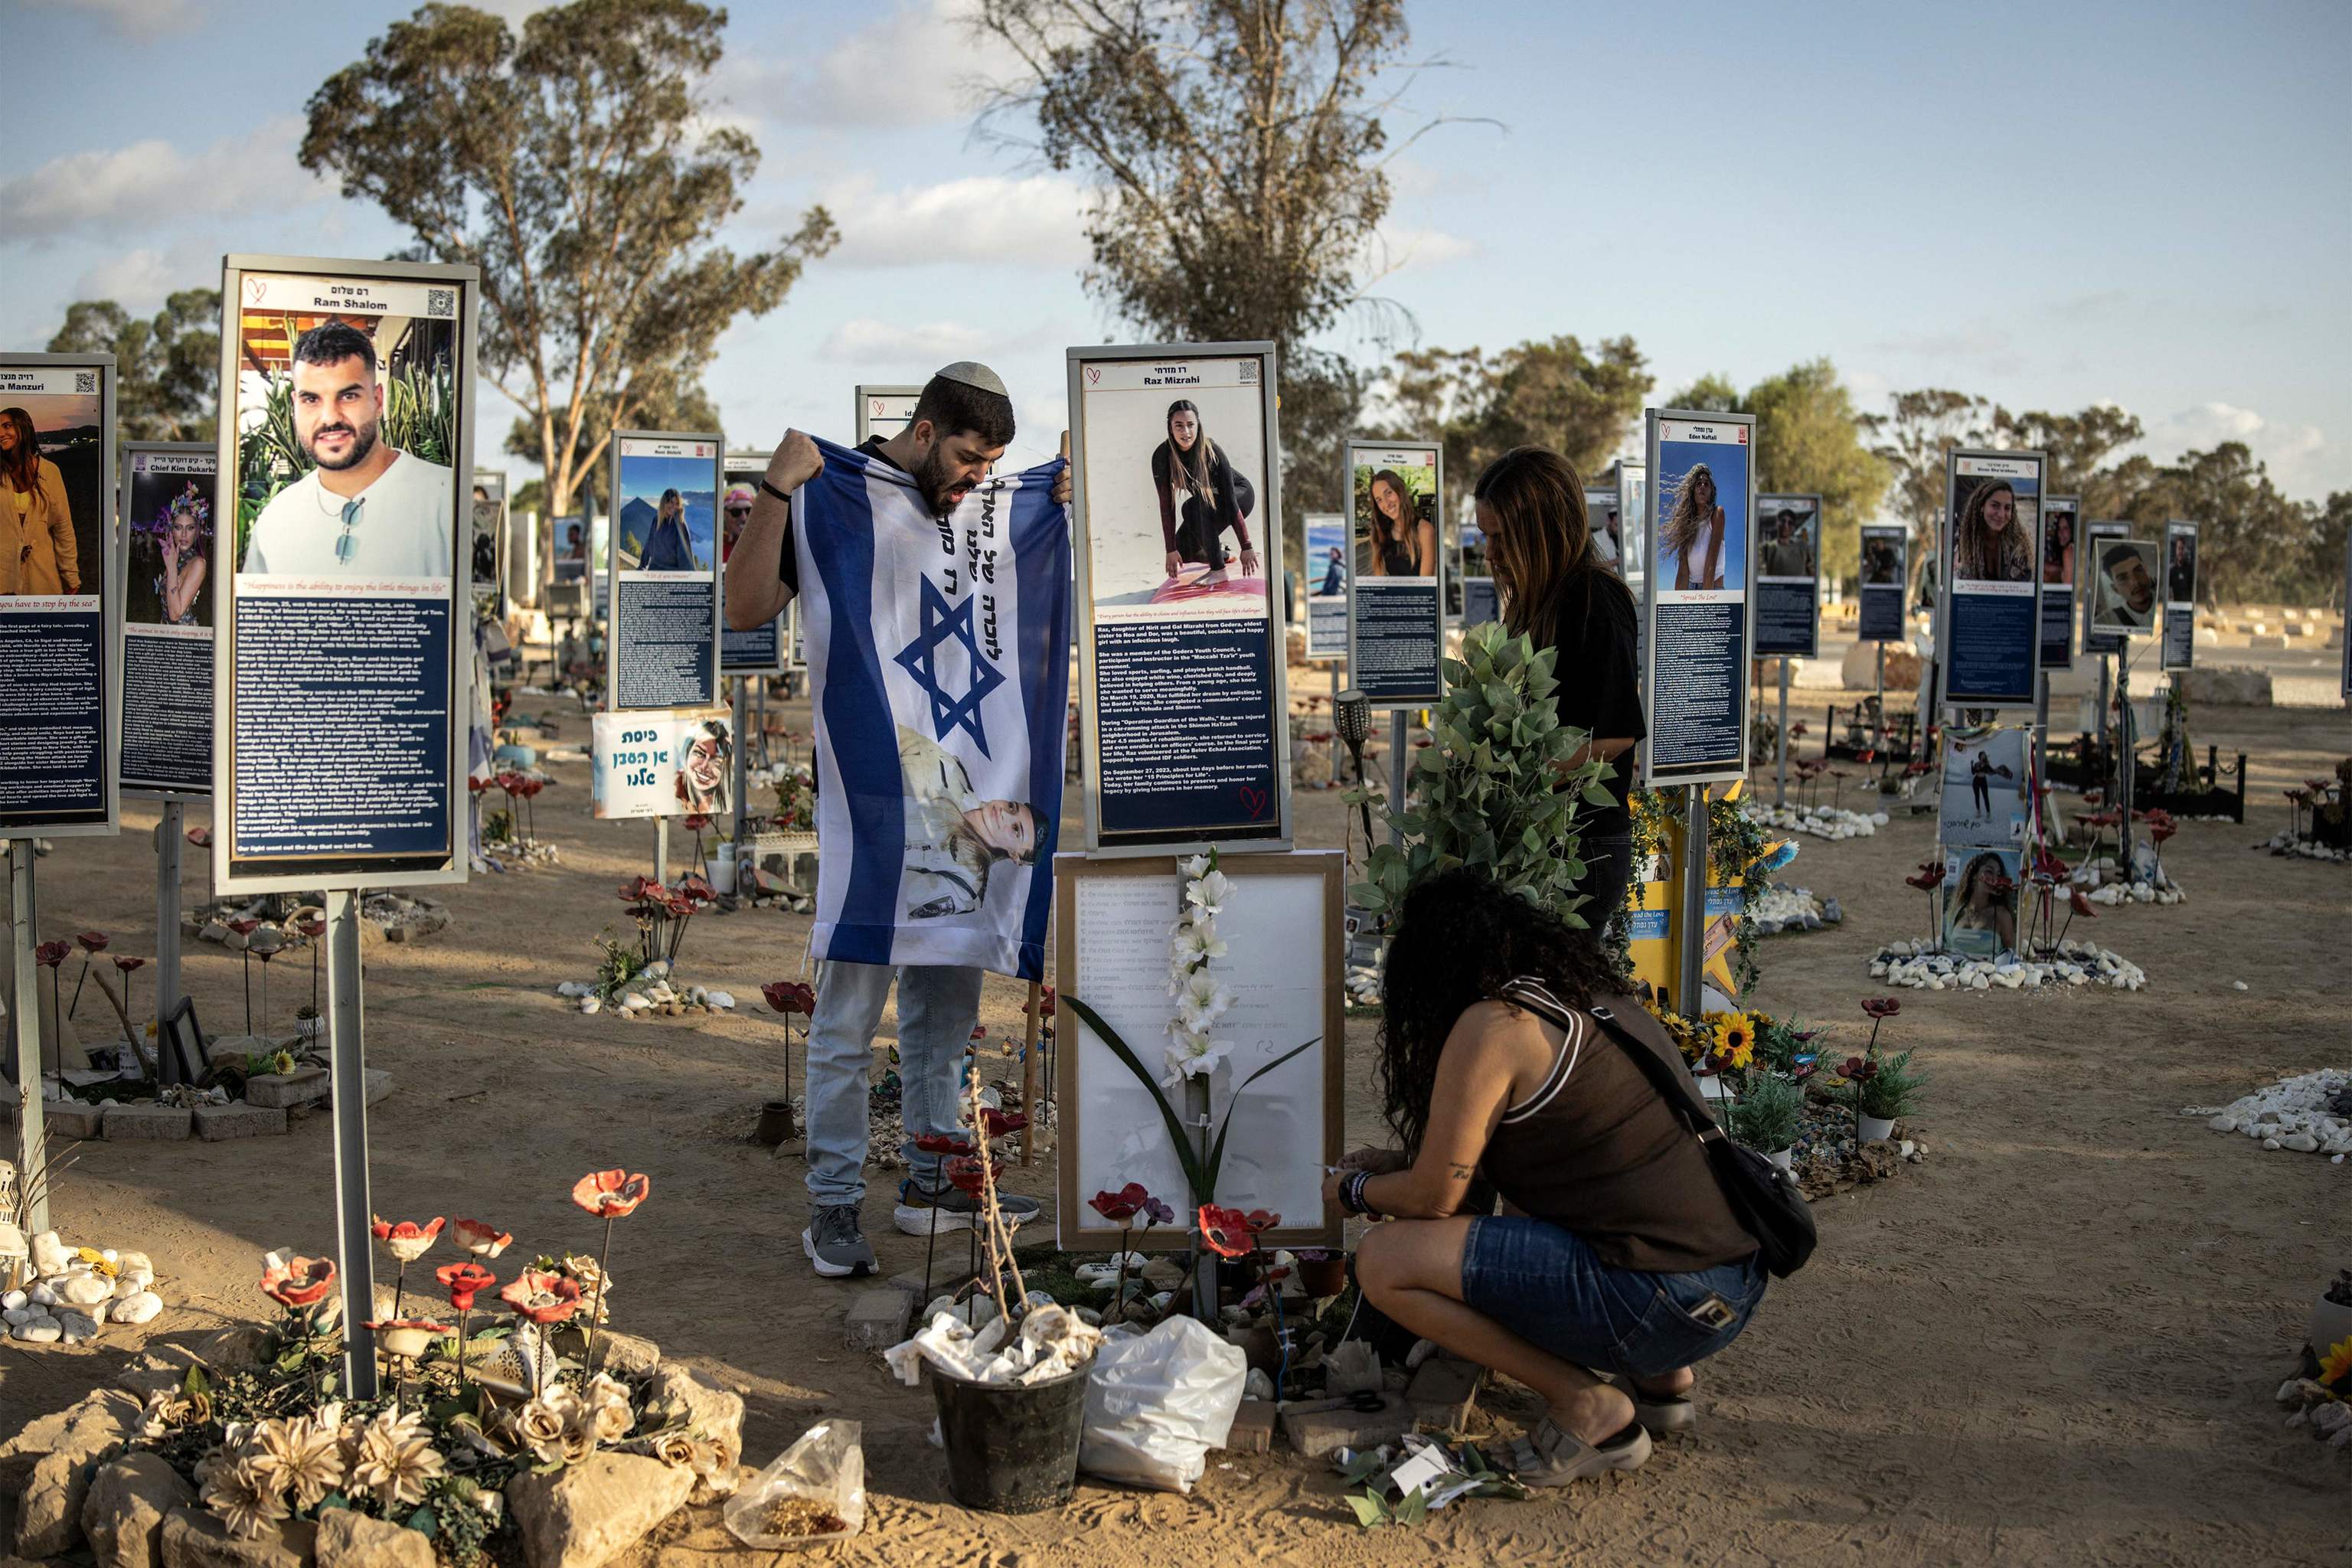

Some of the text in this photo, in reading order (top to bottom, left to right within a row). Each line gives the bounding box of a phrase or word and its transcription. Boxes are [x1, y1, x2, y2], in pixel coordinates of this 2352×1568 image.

[331, 286, 354, 295] שלום
[314, 297, 387, 310] Ram Shalom
[1165, 376, 1200, 384] Mizrahi
[936, 514, 957, 595] רז מזר
[966, 530, 981, 582] שלנו
[982, 550, 997, 585] של
[15, 599, 31, 607] have
[42, 600, 56, 610] stop
[58, 599, 67, 610] by
[69, 599, 79, 607] the
